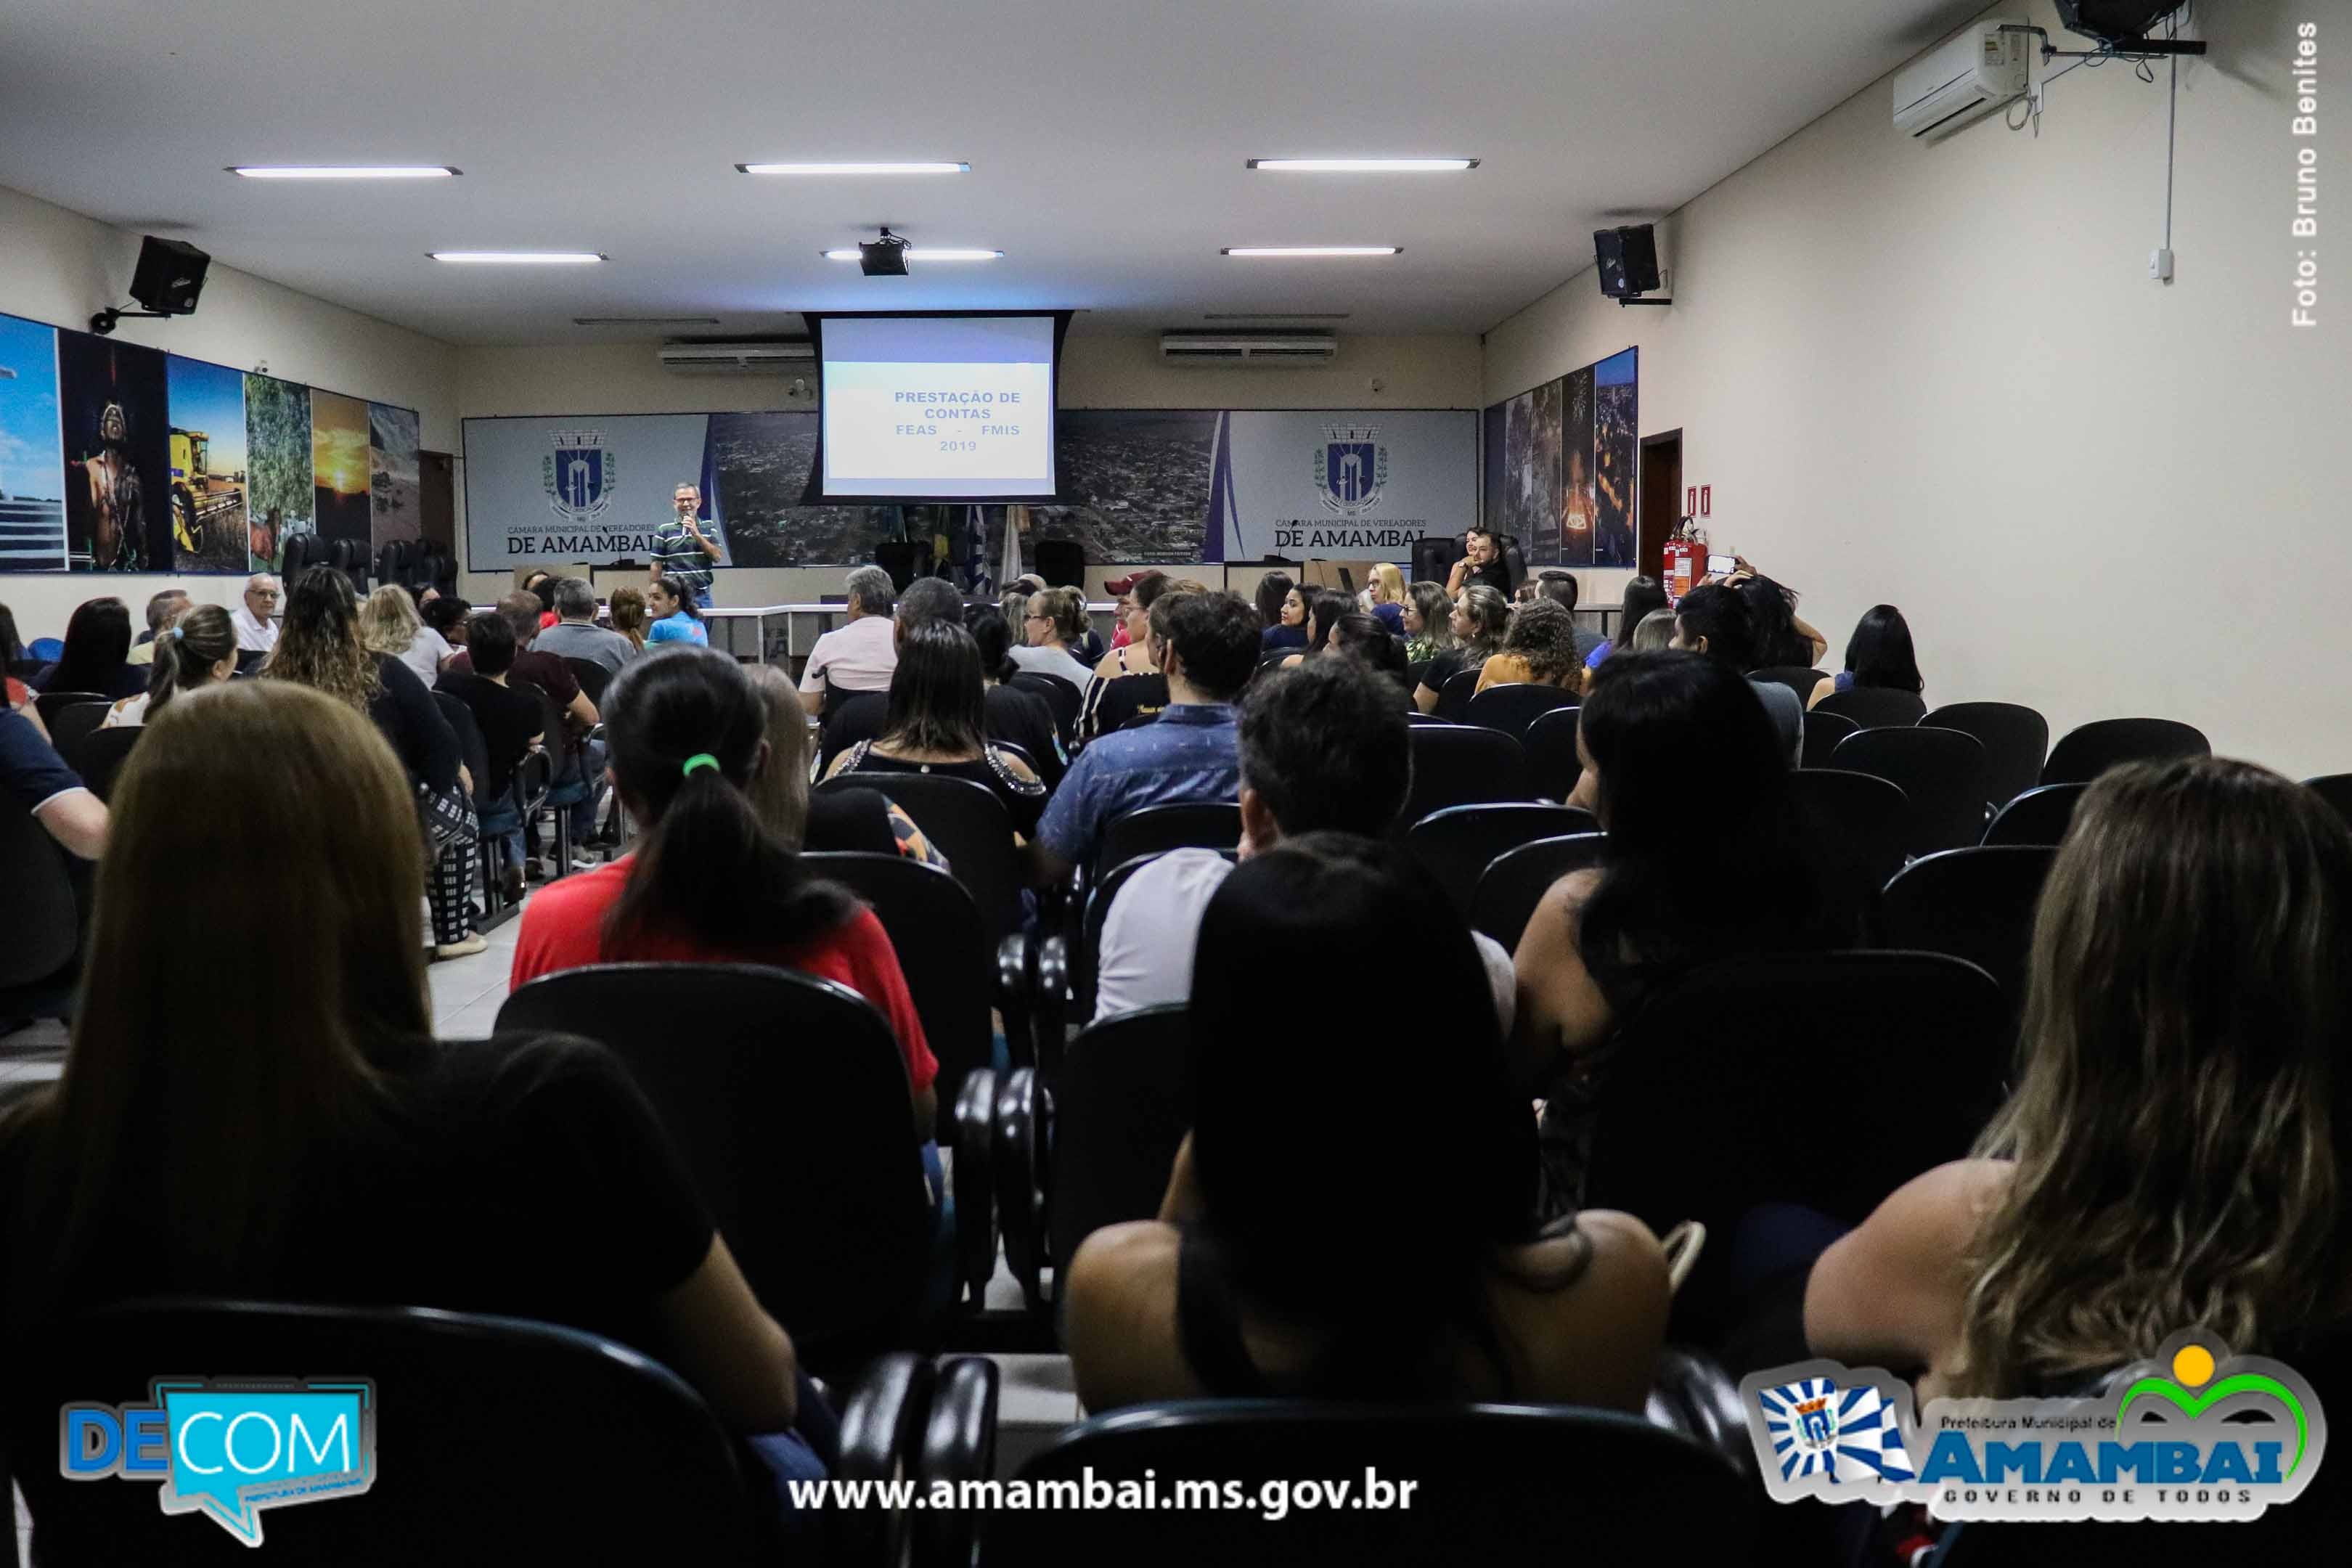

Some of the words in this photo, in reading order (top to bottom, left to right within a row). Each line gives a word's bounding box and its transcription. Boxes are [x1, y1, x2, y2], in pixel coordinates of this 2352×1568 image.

[895, 390, 993, 405] PRESTAÇÃO
[999, 392, 1021, 403] DE
[925, 408, 991, 419] CONTAS
[896, 425, 937, 435] FEAS
[981, 425, 1020, 435] FMIS
[940, 441, 976, 451] 2019
[545, 525, 589, 534] MUNICIPAL
[591, 524, 602, 533] DE
[1275, 530, 1304, 547] DE
[507, 536, 536, 554] DE
